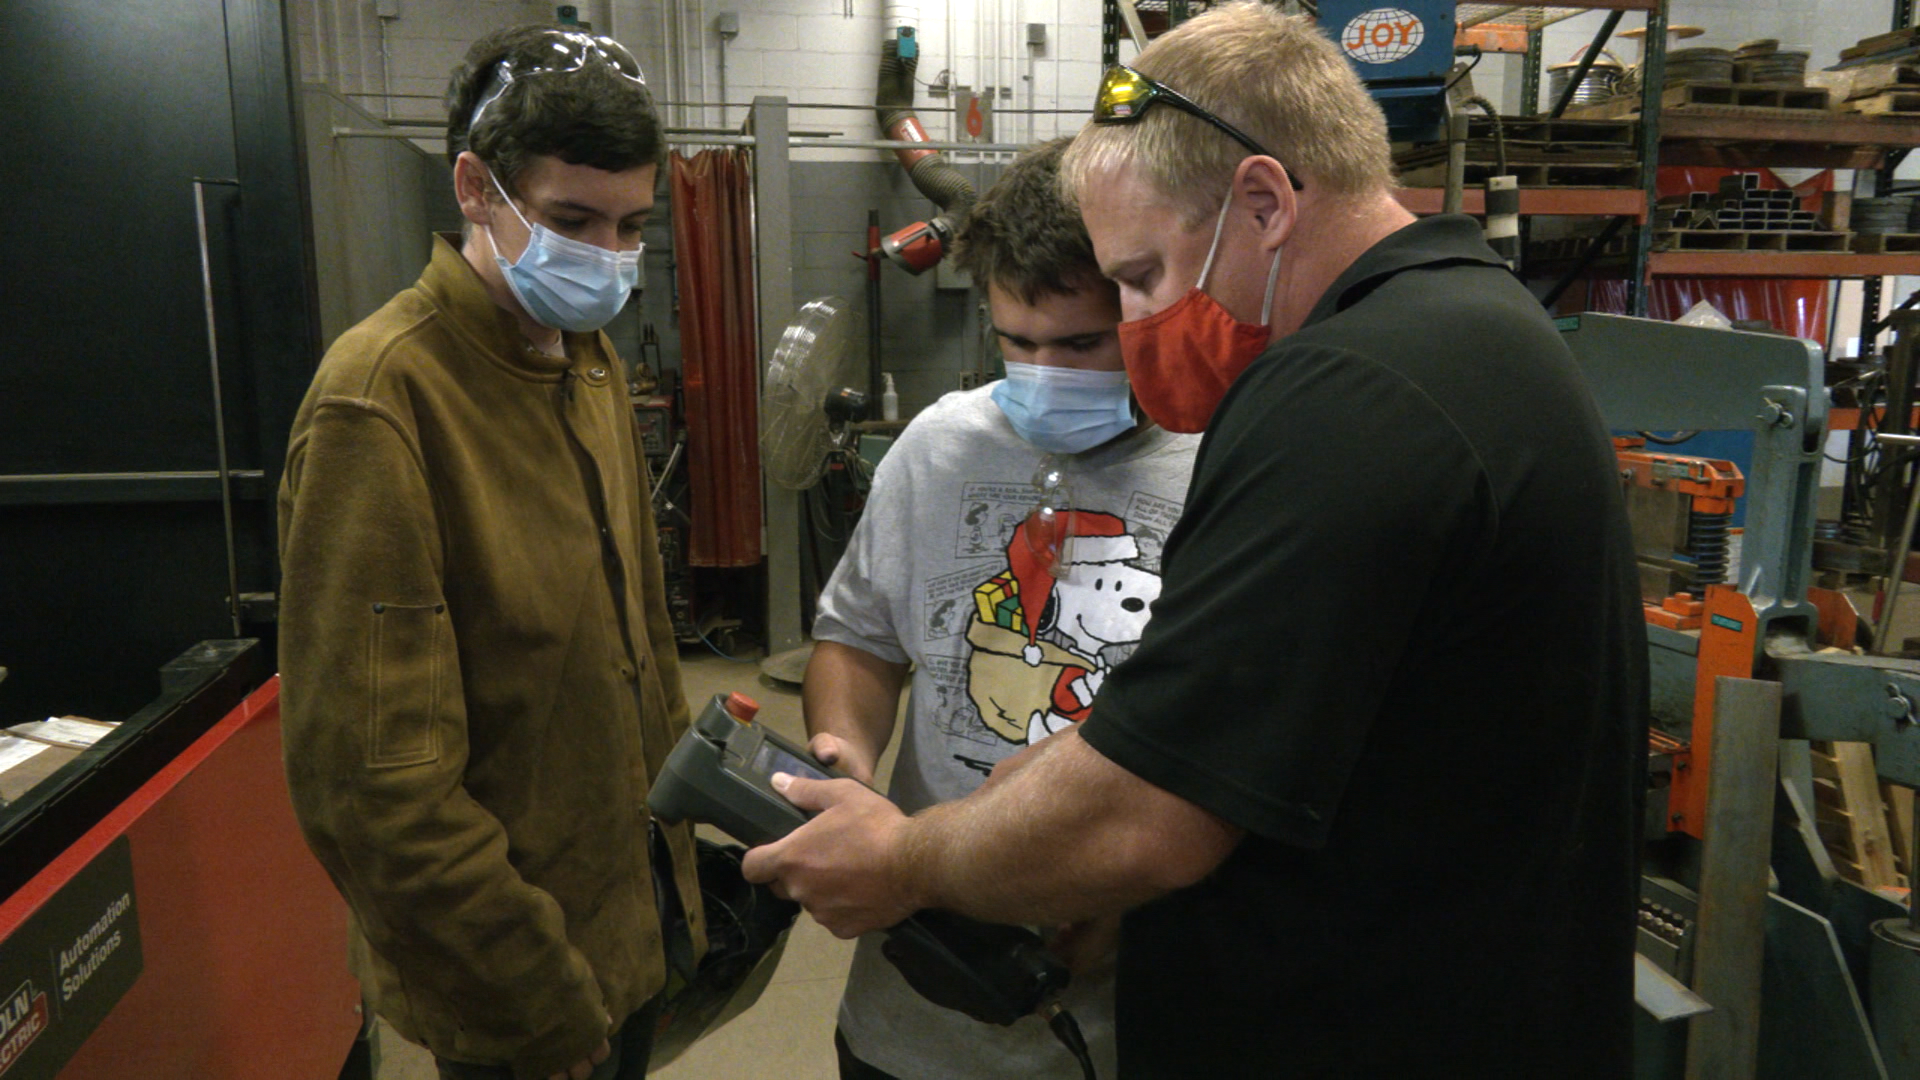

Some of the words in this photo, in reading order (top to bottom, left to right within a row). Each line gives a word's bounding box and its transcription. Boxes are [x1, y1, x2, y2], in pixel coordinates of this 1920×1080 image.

[1346, 20, 1417, 50] JOY
[966, 97, 983, 137] 6
[60, 893, 131, 976] Automation
[62, 930, 122, 1001] Solutions
